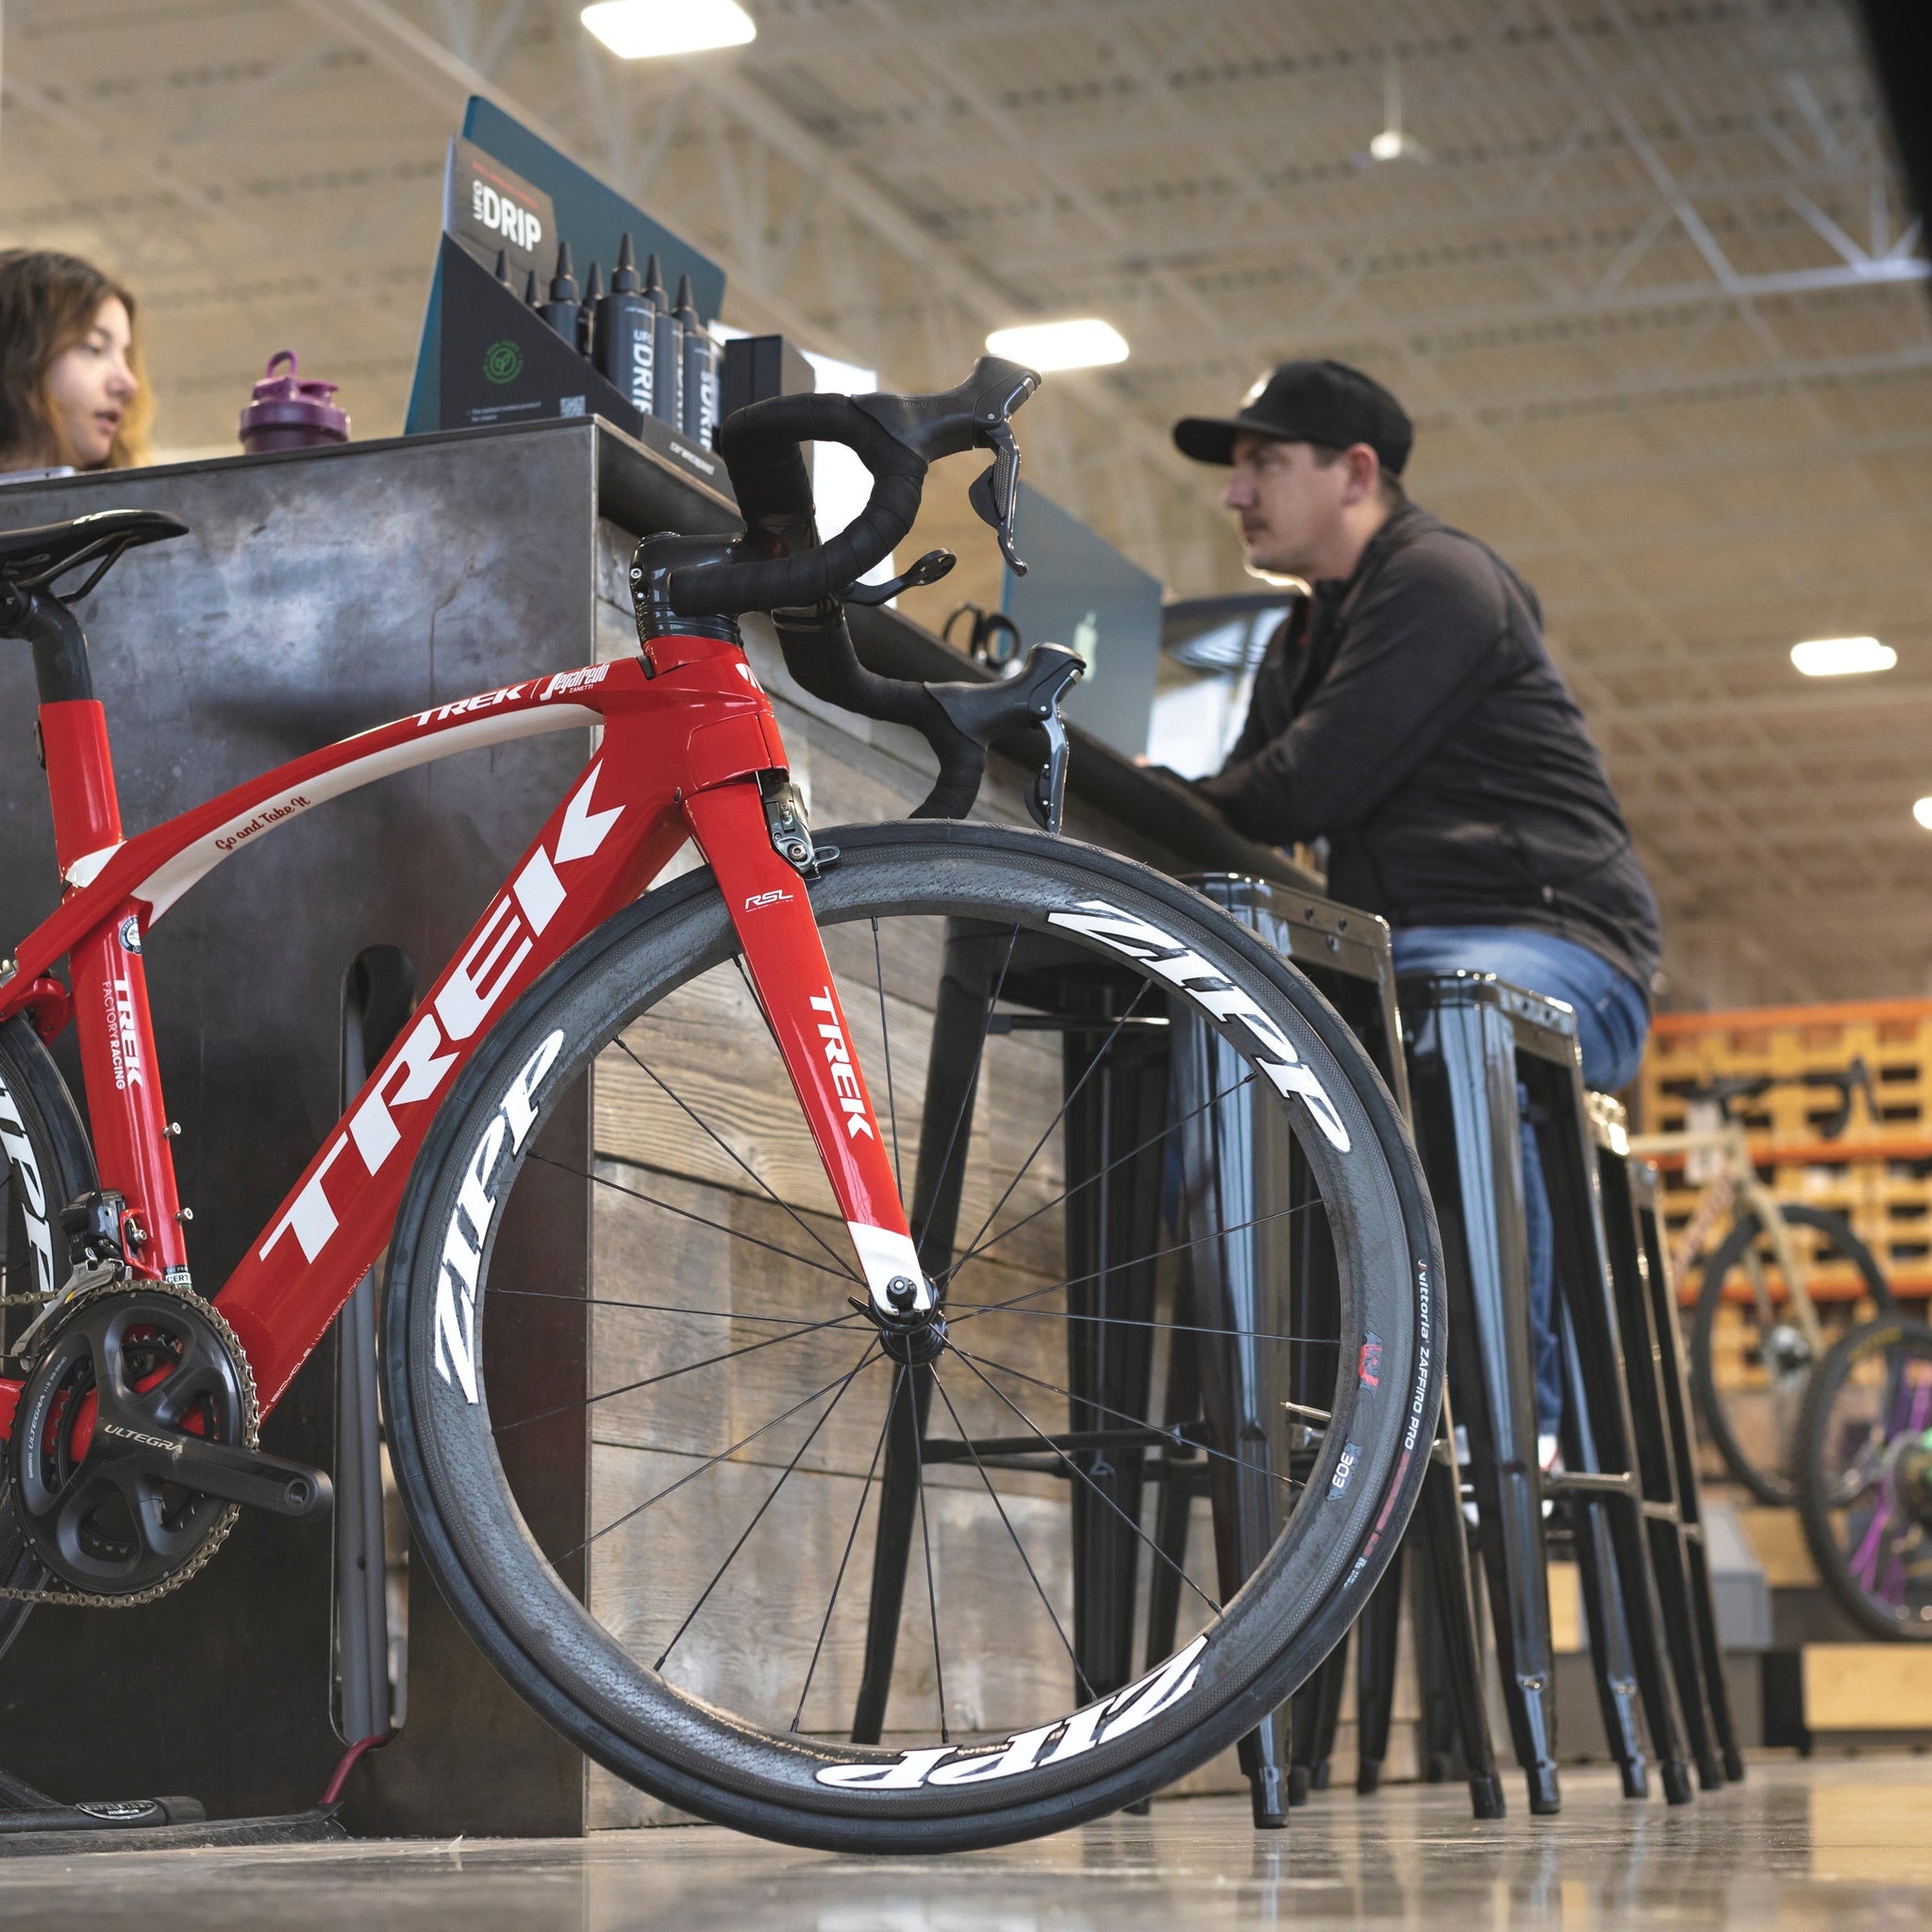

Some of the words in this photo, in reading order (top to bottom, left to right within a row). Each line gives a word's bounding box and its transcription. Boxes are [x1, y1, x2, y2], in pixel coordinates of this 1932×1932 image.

[483, 185, 541, 252] DRIP
[413, 683, 528, 726] TREK
[569, 684, 594, 693] ZANETTI
[215, 838, 237, 851] Go
[236, 819, 264, 839] and
[258, 808, 295, 824] Take
[291, 795, 311, 808] It
[745, 890, 793, 909] RSL
[101, 980, 120, 1039] FACTORY
[114, 971, 143, 1089] TREK
[259, 759, 626, 1264] TREK
[1047, 900, 1352, 1154] ZIPP
[108, 1040, 125, 1091] RACING
[809, 985, 874, 1141] TREK
[0, 1075, 55, 1308] IPP
[434, 1029, 565, 1405] ZIPP
[270, 1347, 312, 1403] BICYCLE
[1412, 1345, 1430, 1415] ZAFFIRO
[28, 1395, 46, 1450] ULTEGRA
[104, 1424, 183, 1454] ULTEGRA
[1404, 1415, 1420, 1451] PRO
[1331, 1451, 1355, 1489] 303
[815, 1634, 1209, 1790] ZIPP
